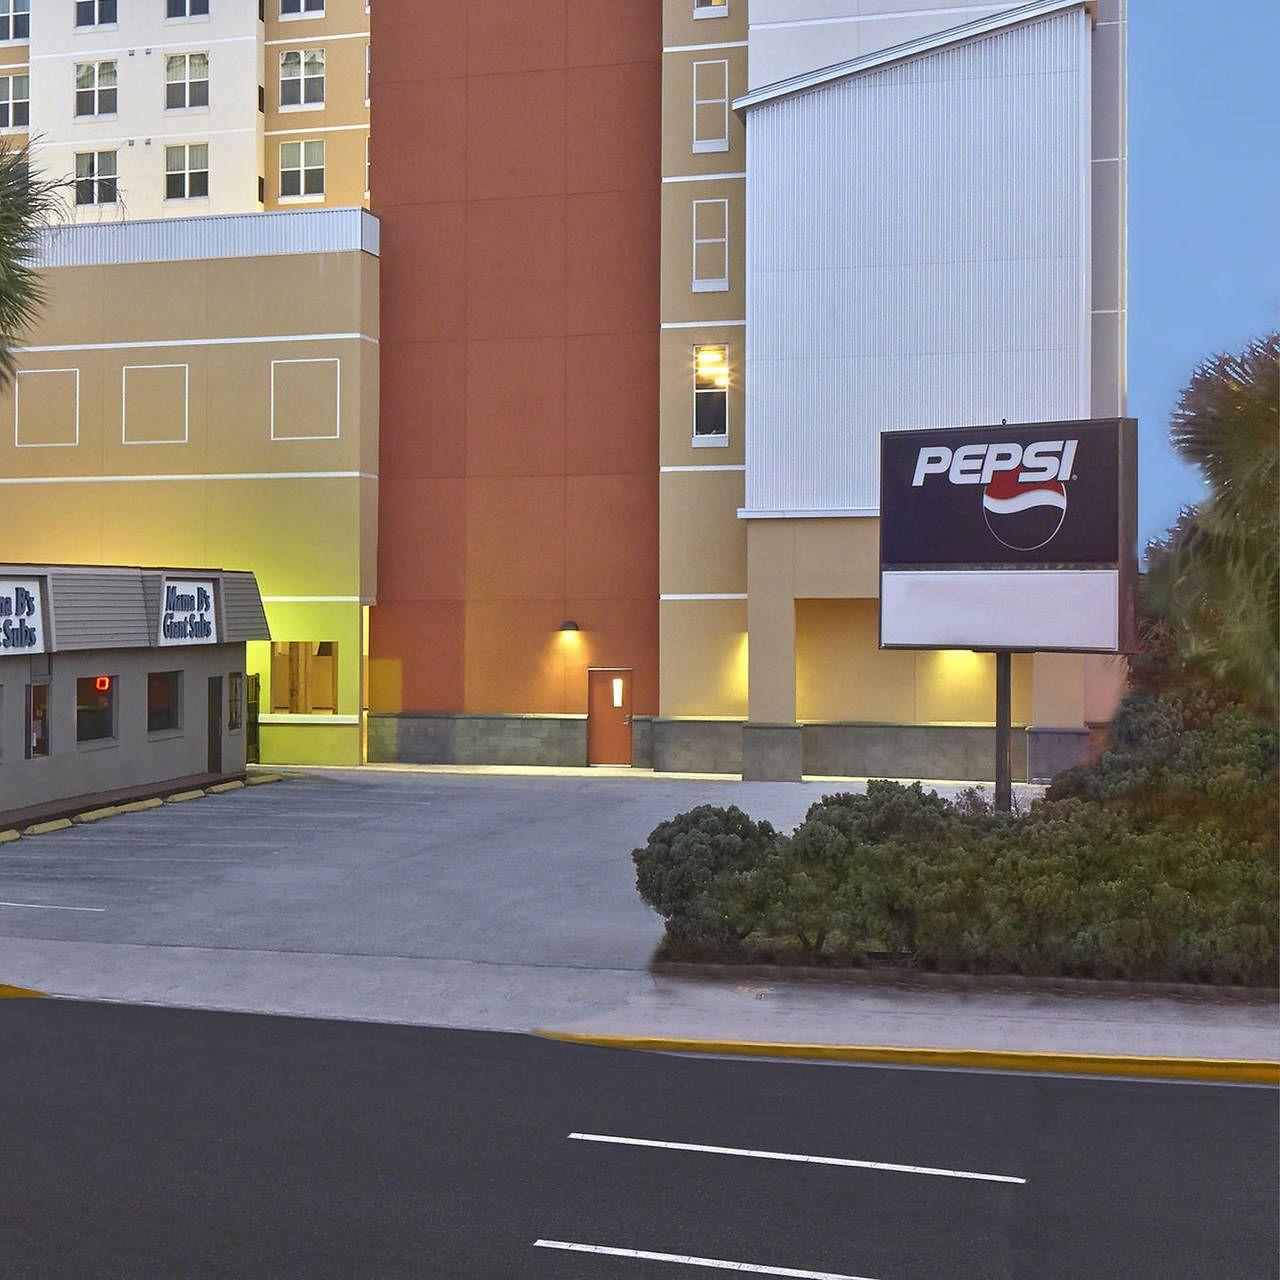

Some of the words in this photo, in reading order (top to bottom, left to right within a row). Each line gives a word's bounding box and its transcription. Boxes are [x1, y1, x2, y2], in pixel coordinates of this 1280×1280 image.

[912, 440, 1079, 486] PEPSI
[15, 587, 35, 616] B's
[165, 586, 195, 611] Mama
[197, 587, 210, 611] B's
[3, 619, 37, 648] Subs
[163, 613, 188, 639] Giant
[189, 613, 212, 638] Subs
